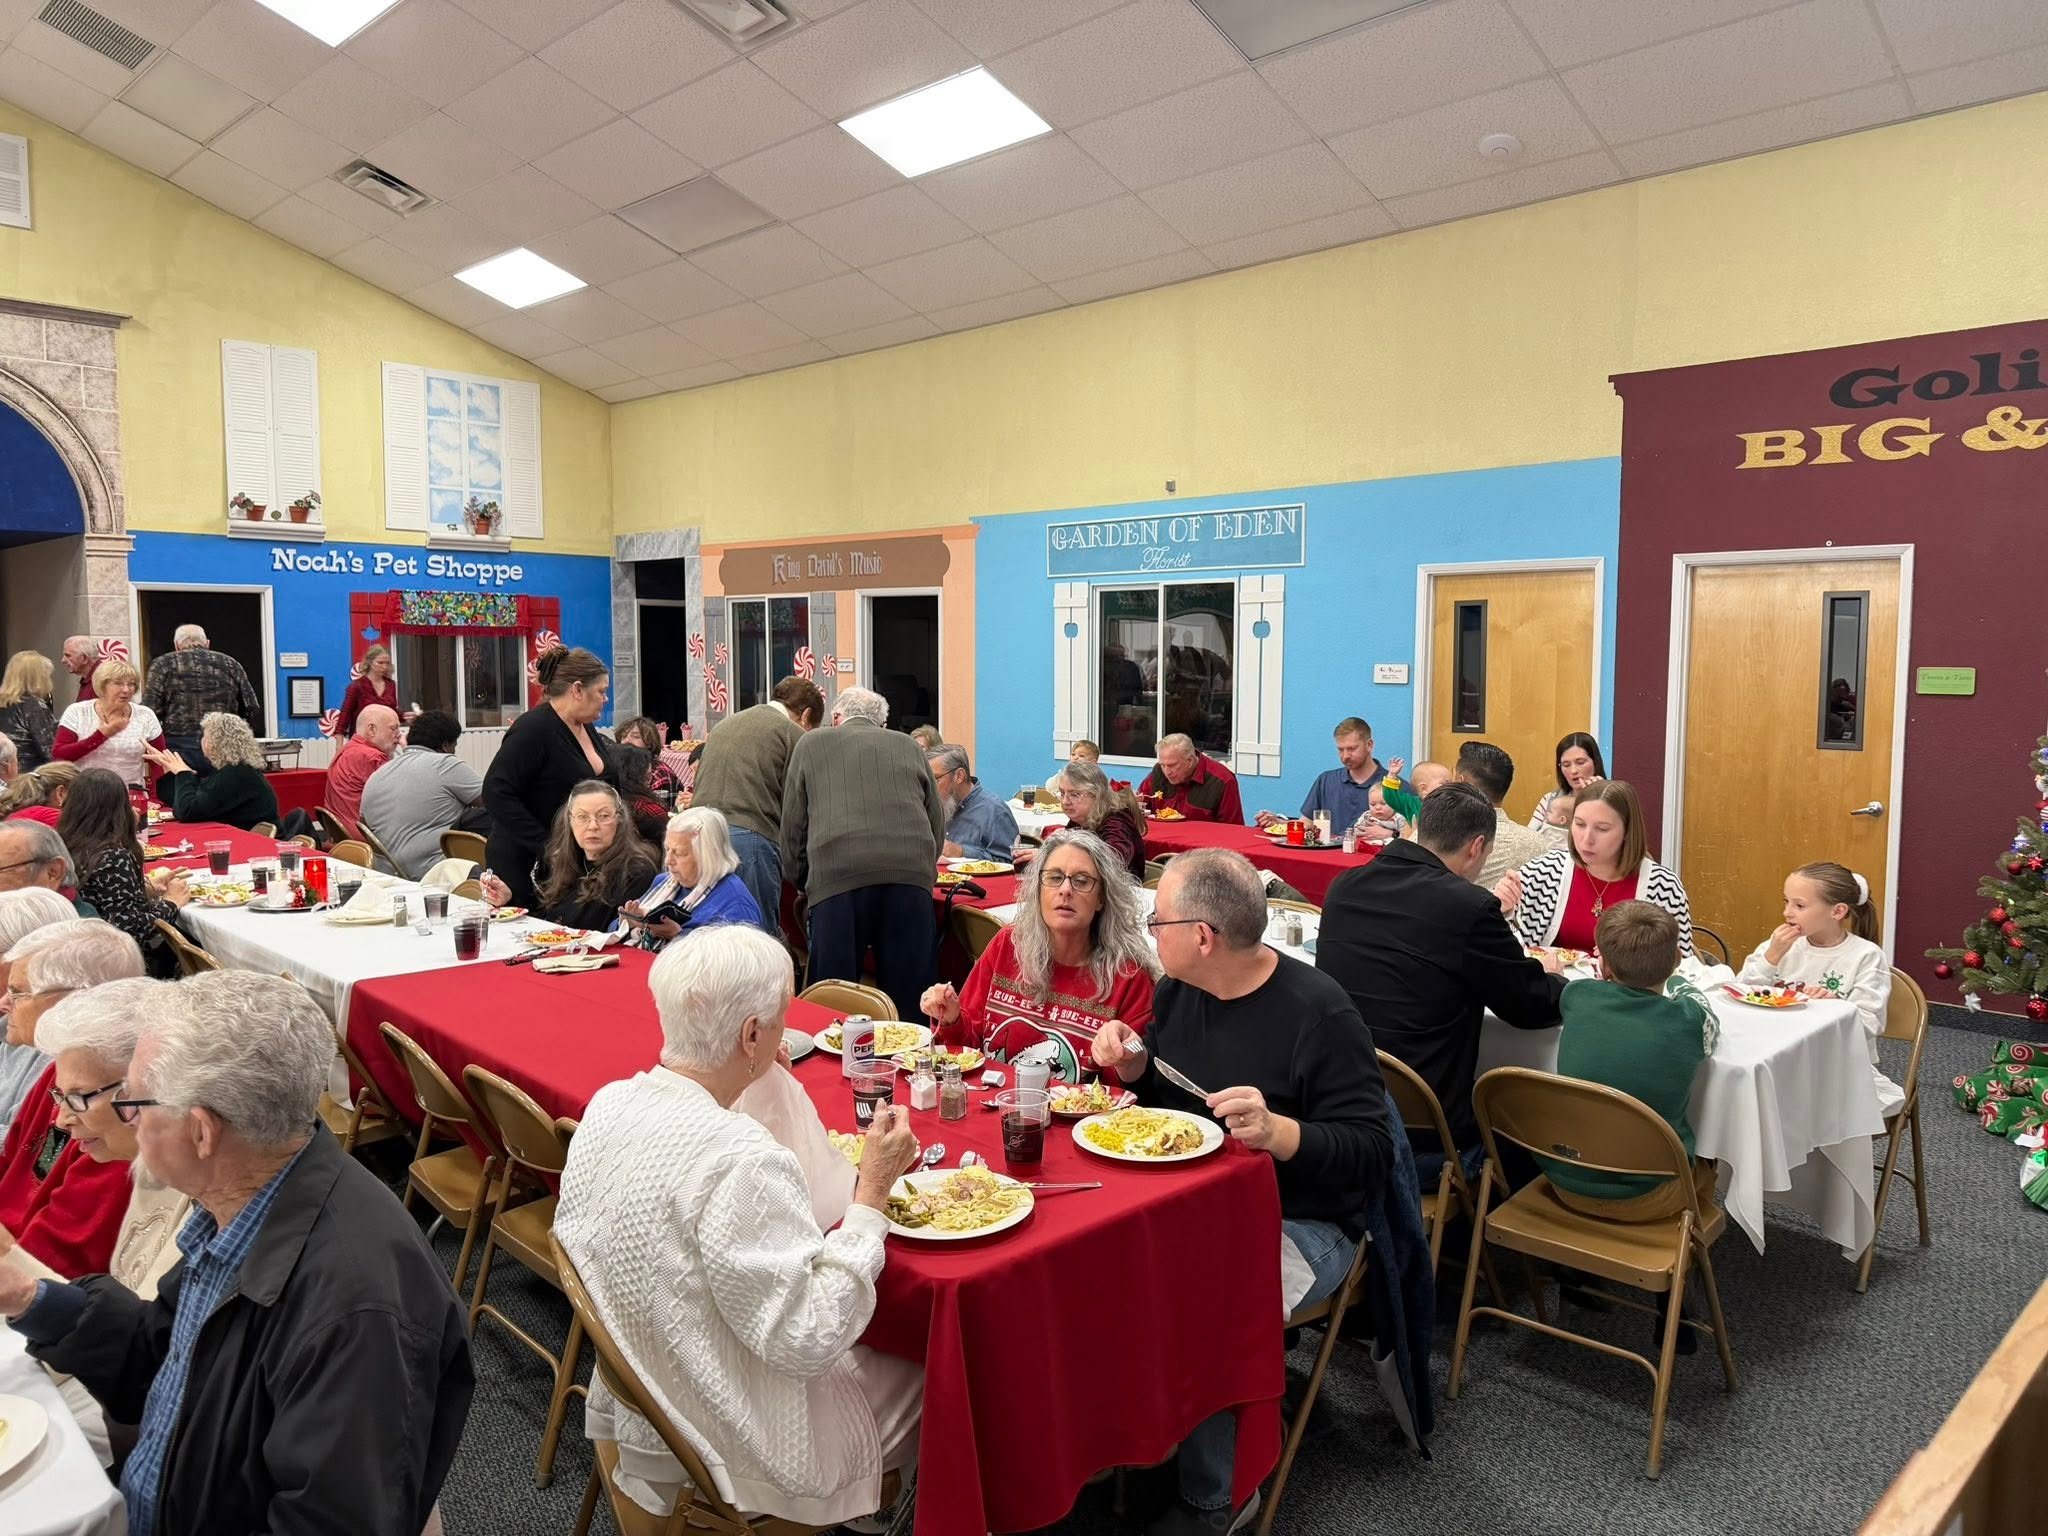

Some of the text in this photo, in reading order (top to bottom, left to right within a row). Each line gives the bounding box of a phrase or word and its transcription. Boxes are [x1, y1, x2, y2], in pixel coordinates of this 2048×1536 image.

[1829, 349, 2048, 409] Goli
[1735, 406, 2048, 469] BIG &
[1051, 508, 1299, 550] GARDEN OF EDEN
[270, 548, 523, 584] Noah's Pet Shoppe
[772, 551, 883, 584] King David's Music
[1139, 547, 1192, 571] Florist
[993, 990, 1104, 1029] BUC-EES BUC-EE'
